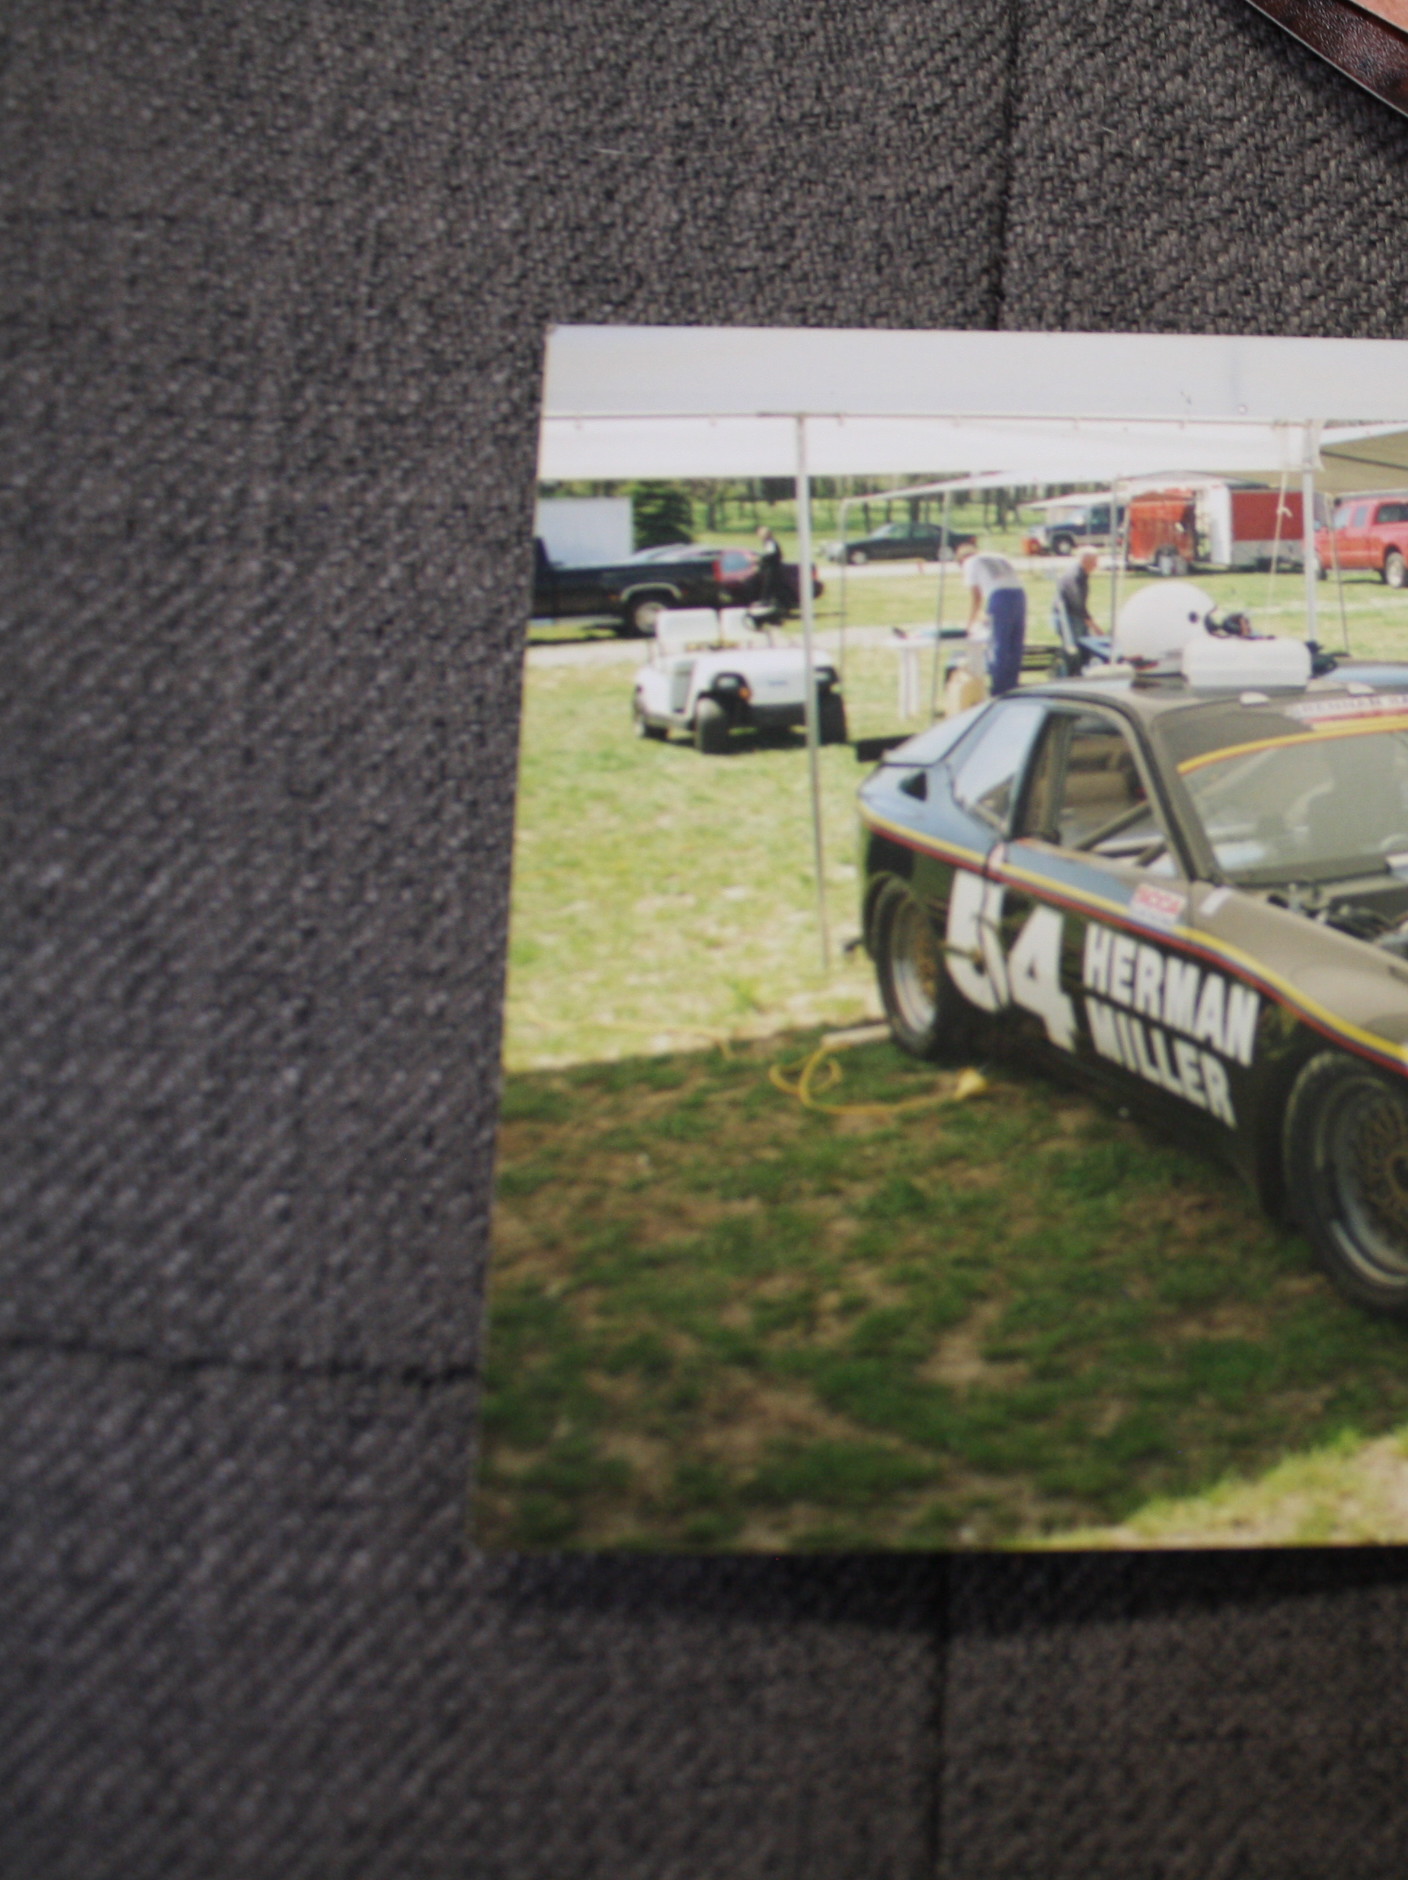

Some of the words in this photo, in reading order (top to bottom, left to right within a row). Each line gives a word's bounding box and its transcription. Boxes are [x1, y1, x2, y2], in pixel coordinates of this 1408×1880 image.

[944, 842, 1078, 1054] 54
[1082, 921, 1260, 1068] HERMAN
[1084, 996, 1237, 1131] MILLER
